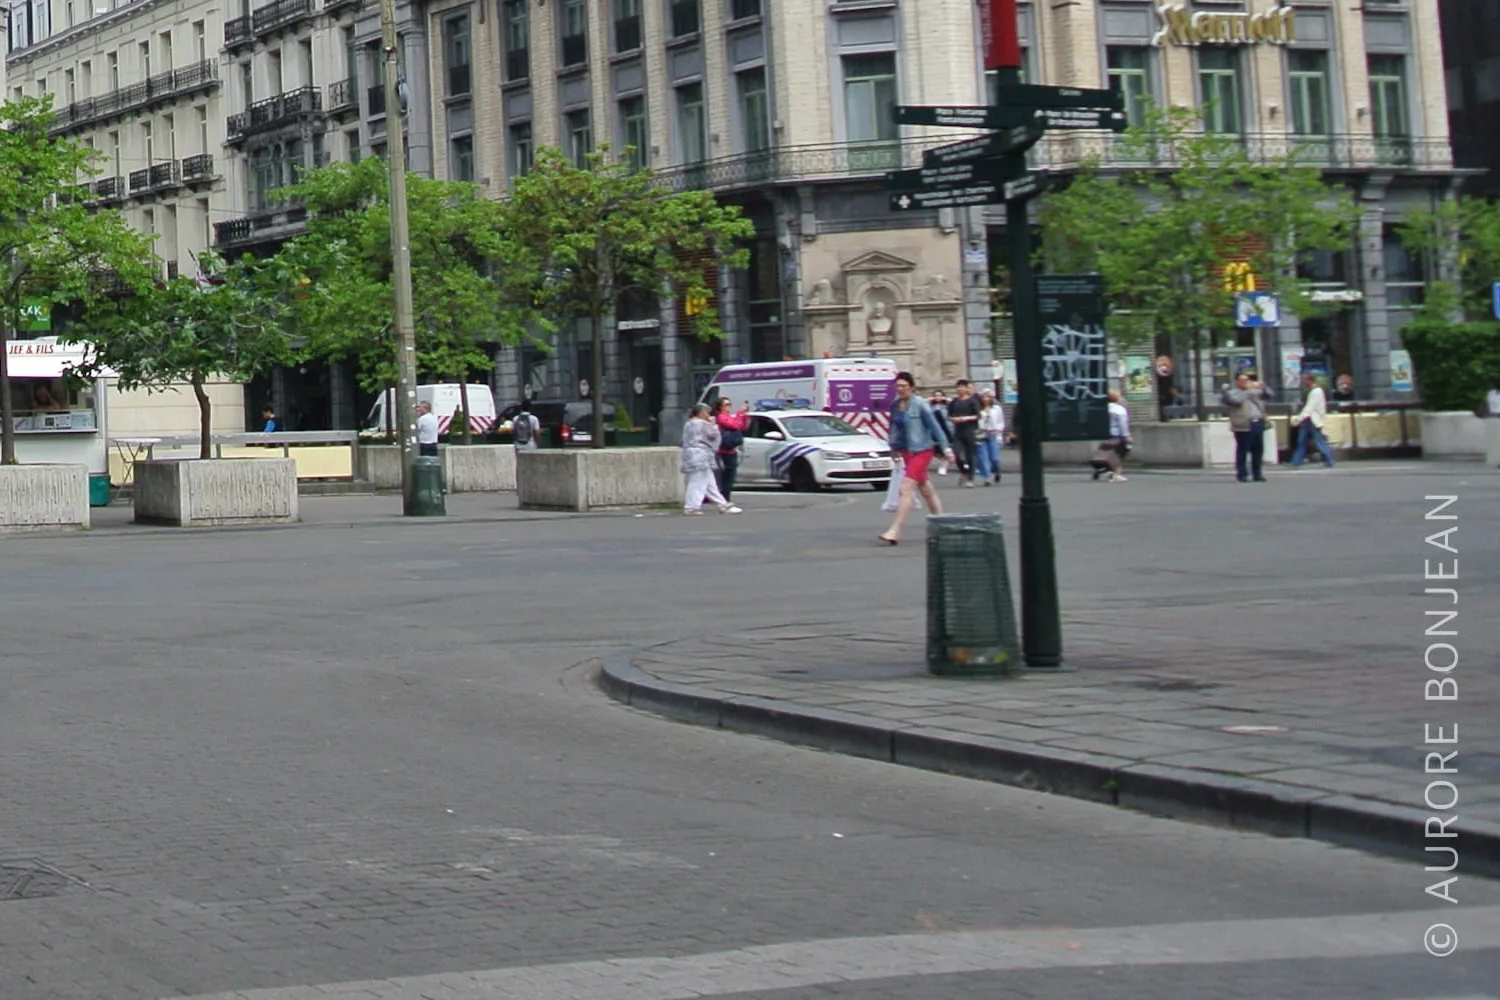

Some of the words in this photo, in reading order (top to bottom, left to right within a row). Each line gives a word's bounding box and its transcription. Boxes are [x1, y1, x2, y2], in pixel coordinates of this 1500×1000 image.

[1151, 3, 1296, 47] Marriott
[9, 345, 24, 355] JEF
[26, 345, 33, 355] &
[35, 344, 54, 354] FILS
